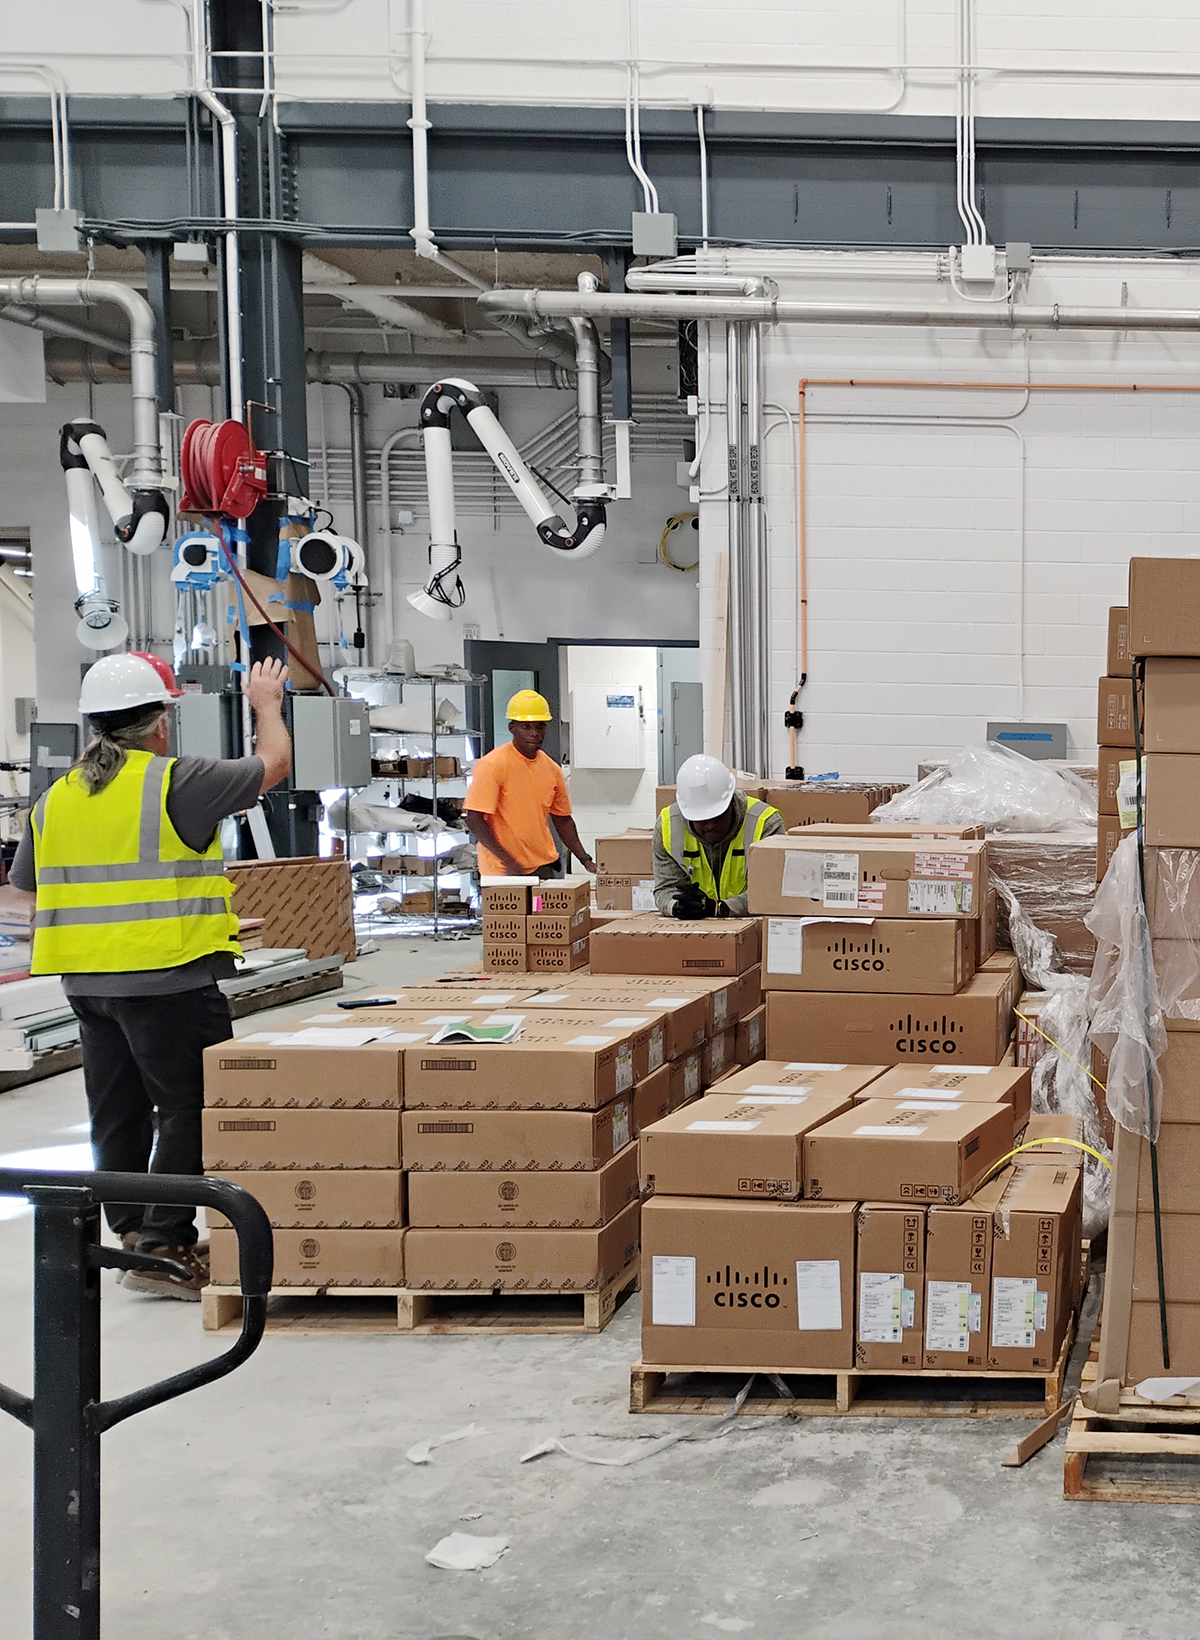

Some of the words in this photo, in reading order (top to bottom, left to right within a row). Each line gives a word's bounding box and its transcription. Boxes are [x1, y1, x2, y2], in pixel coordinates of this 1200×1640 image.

[489, 931, 518, 939] CISCO
[535, 931, 563, 939] CISCO
[832, 958, 885, 971] CISCO
[896, 1038, 957, 1054] CISCO
[714, 1292, 780, 1308] CISCO
